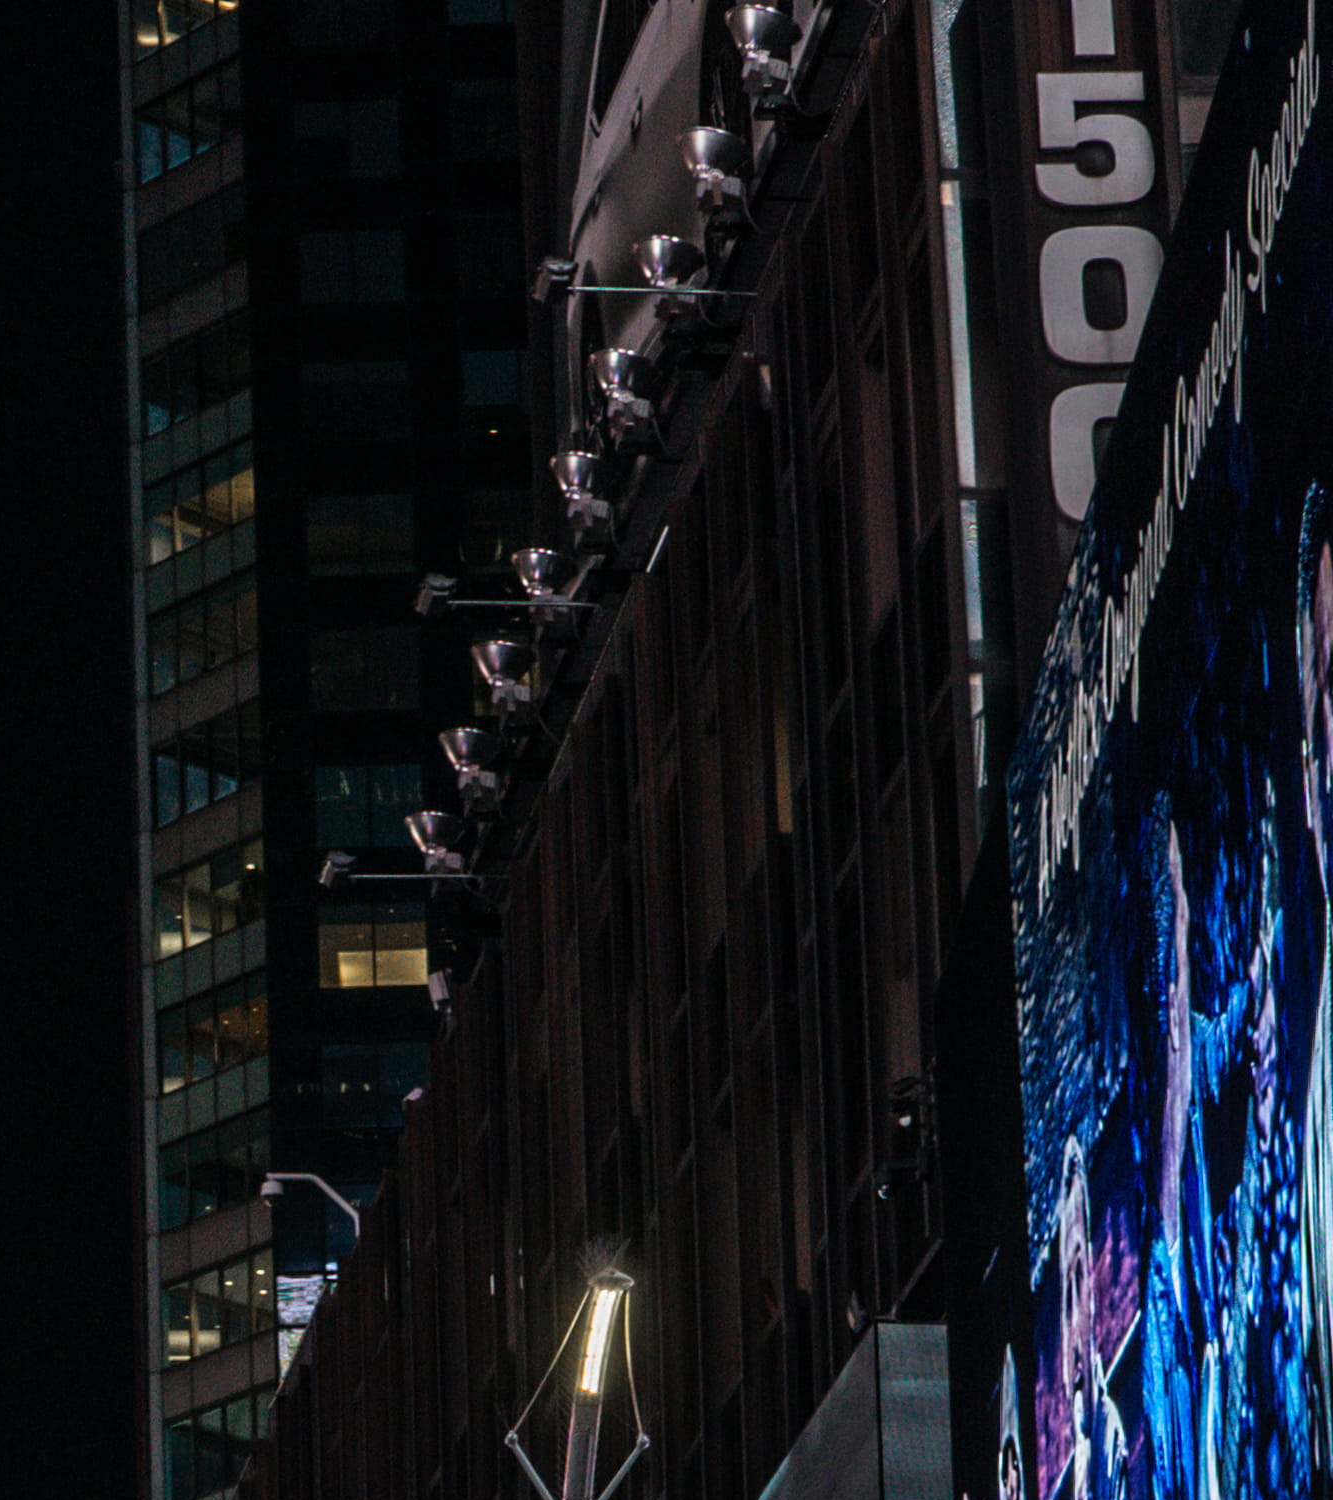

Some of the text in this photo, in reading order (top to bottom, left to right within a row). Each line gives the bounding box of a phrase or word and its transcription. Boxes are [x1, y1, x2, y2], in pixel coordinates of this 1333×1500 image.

[1103, 424, 1174, 723] Original
[1174, 229, 1245, 511] Comedy
[1247, 0, 1320, 314] Special
